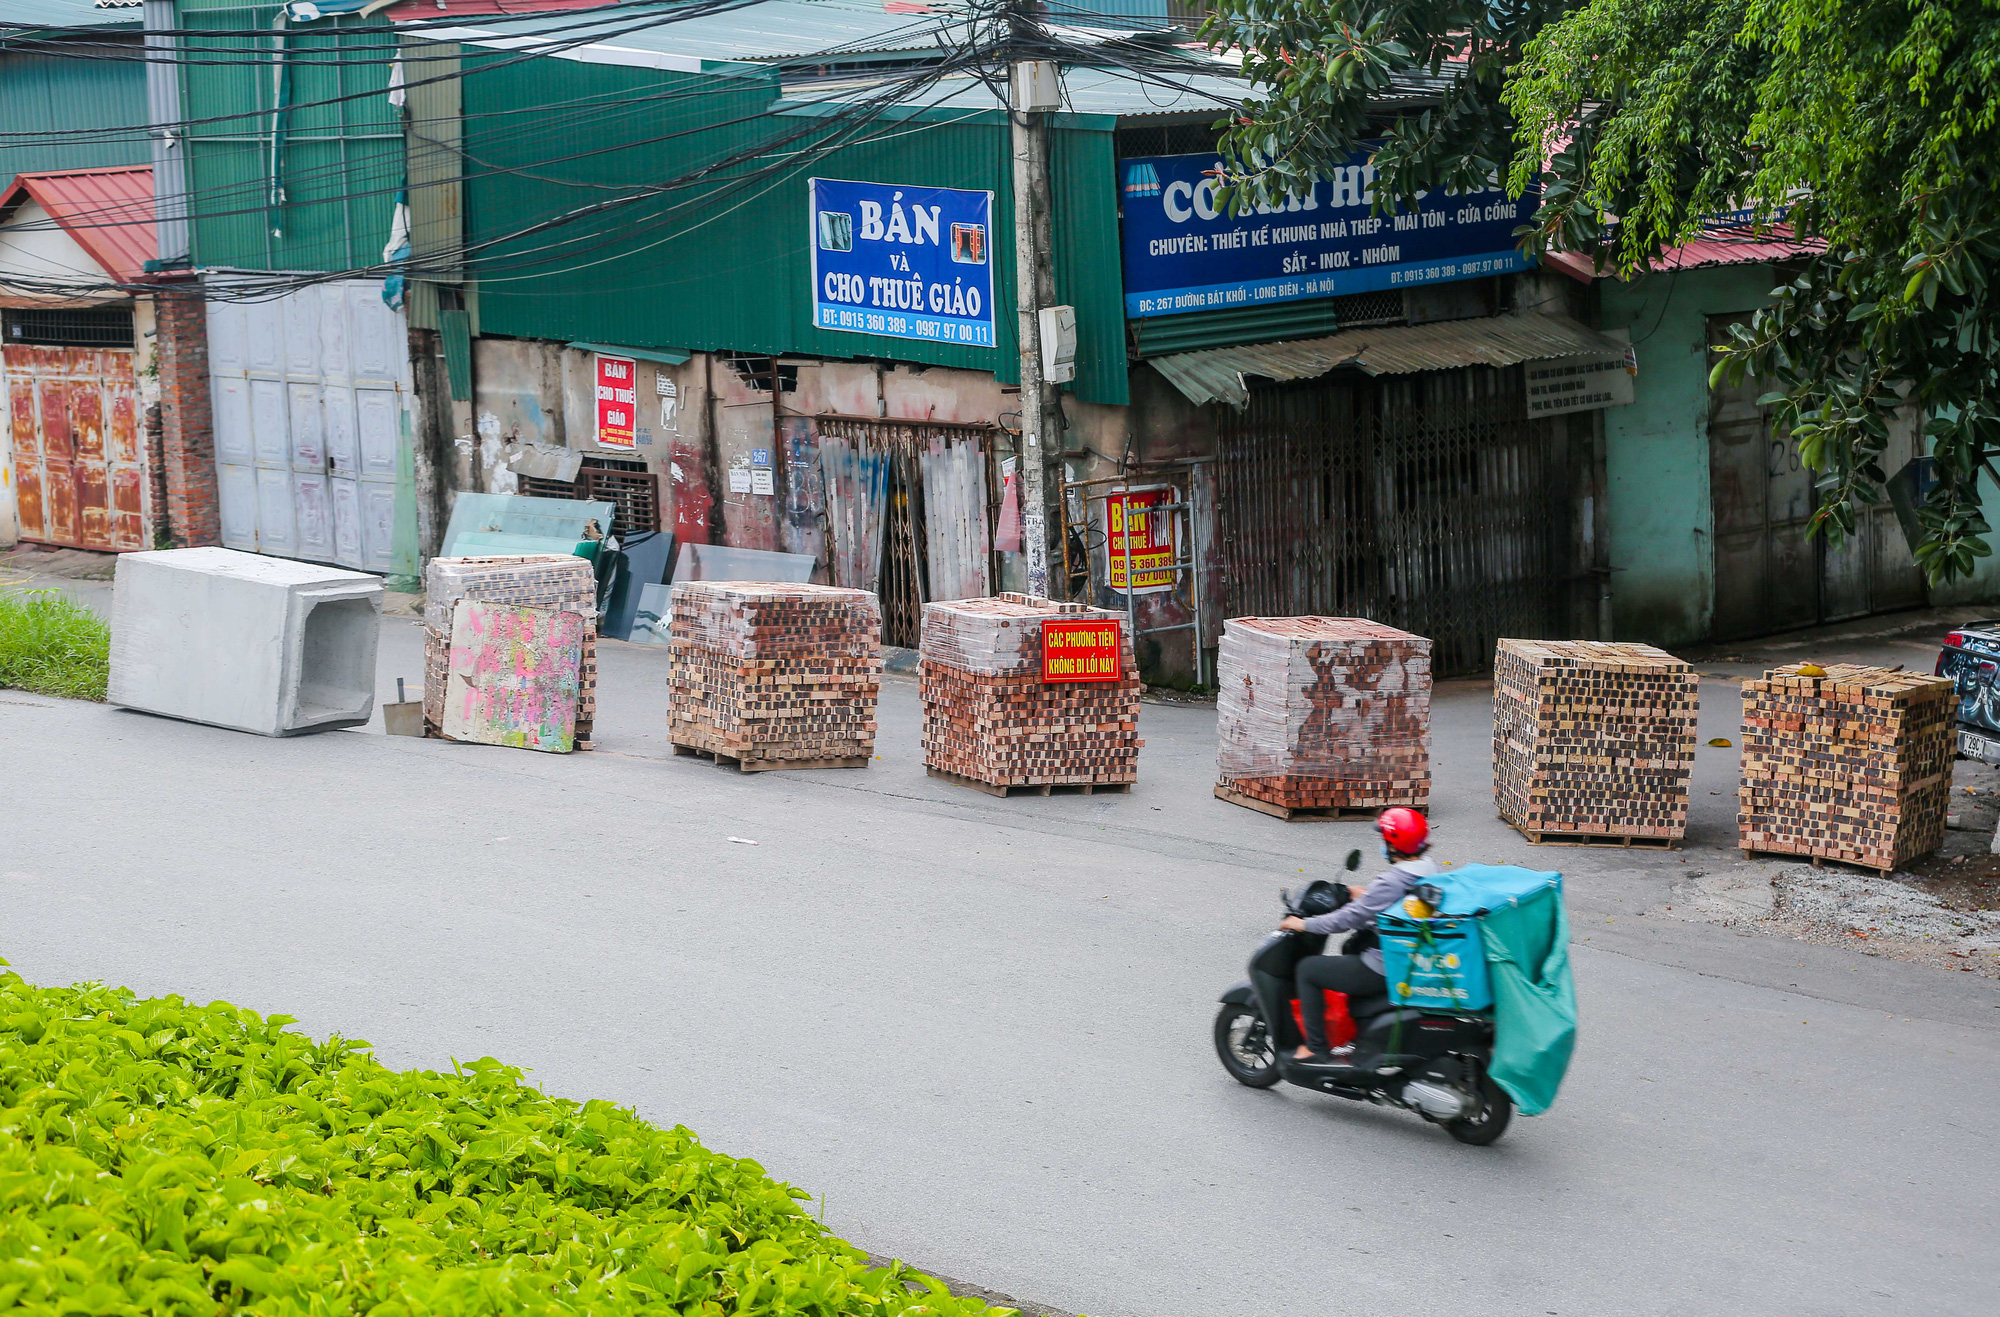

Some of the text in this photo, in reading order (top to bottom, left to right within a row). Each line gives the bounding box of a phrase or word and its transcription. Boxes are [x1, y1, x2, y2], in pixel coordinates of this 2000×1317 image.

[860, 191, 941, 246] BÁN
[1150, 234, 1208, 256] CHUYÊN:
[1212, 227, 1248, 250] THIẾT
[1252, 224, 1269, 246] KẾ
[1273, 224, 1317, 244] KHUNG
[1321, 220, 1347, 240] NHÀ
[1351, 216, 1382, 236] THÉP
[1394, 212, 1418, 232] MÁI
[1422, 209, 1446, 228] TÔN
[1458, 203, 1481, 224] CỬA
[890, 251, 910, 272] VÀ
[1282, 250, 1308, 274] SẮT
[1320, 251, 1350, 270] INOX
[1362, 244, 1400, 264] NHÔM
[1405, 270, 1424, 282] 0915
[1426, 267, 1440, 280] 360
[1442, 264, 1456, 278] 389
[1462, 262, 1480, 274] 0987
[1482, 260, 1492, 272] 97
[1494, 259, 1503, 270] 00
[1505, 258, 1513, 268] 11
[824, 271, 981, 317] CHO THUÊ GIÁO
[1140, 300, 1155, 312] ĐC:
[1156, 297, 1172, 311] 267
[1175, 292, 1205, 308] ĐƯỜNG
[1208, 289, 1224, 304] BÁT
[1226, 286, 1246, 302] KHỐI
[1254, 286, 1277, 300] LONG
[1278, 282, 1299, 297] BIÊN
[1306, 278, 1318, 294] HÀ
[1320, 278, 1334, 294] NỘI
[840, 310, 864, 329] 0915
[866, 315, 885, 331] 360
[888, 316, 906, 333] 389
[916, 320, 940, 338] 0987
[944, 323, 956, 339] 97
[959, 325, 972, 341] 00
[976, 326, 987, 343] 11
[604, 361, 626, 380] BÁN
[598, 386, 634, 404] CHO THUÊ
[607, 409, 626, 426] GIÁO
[753, 451, 766, 462] 267
[1130, 532, 1147, 549] THUÊ
[1114, 560, 1136, 570] 095
[1140, 558, 1156, 568] 360
[1048, 628, 1114, 650] CÁC PHƯƠNG TIỆN
[1049, 652, 1114, 674] KHÔNG ĐI LỐI NÀY
[1968, 736, 1980, 751] 29C
